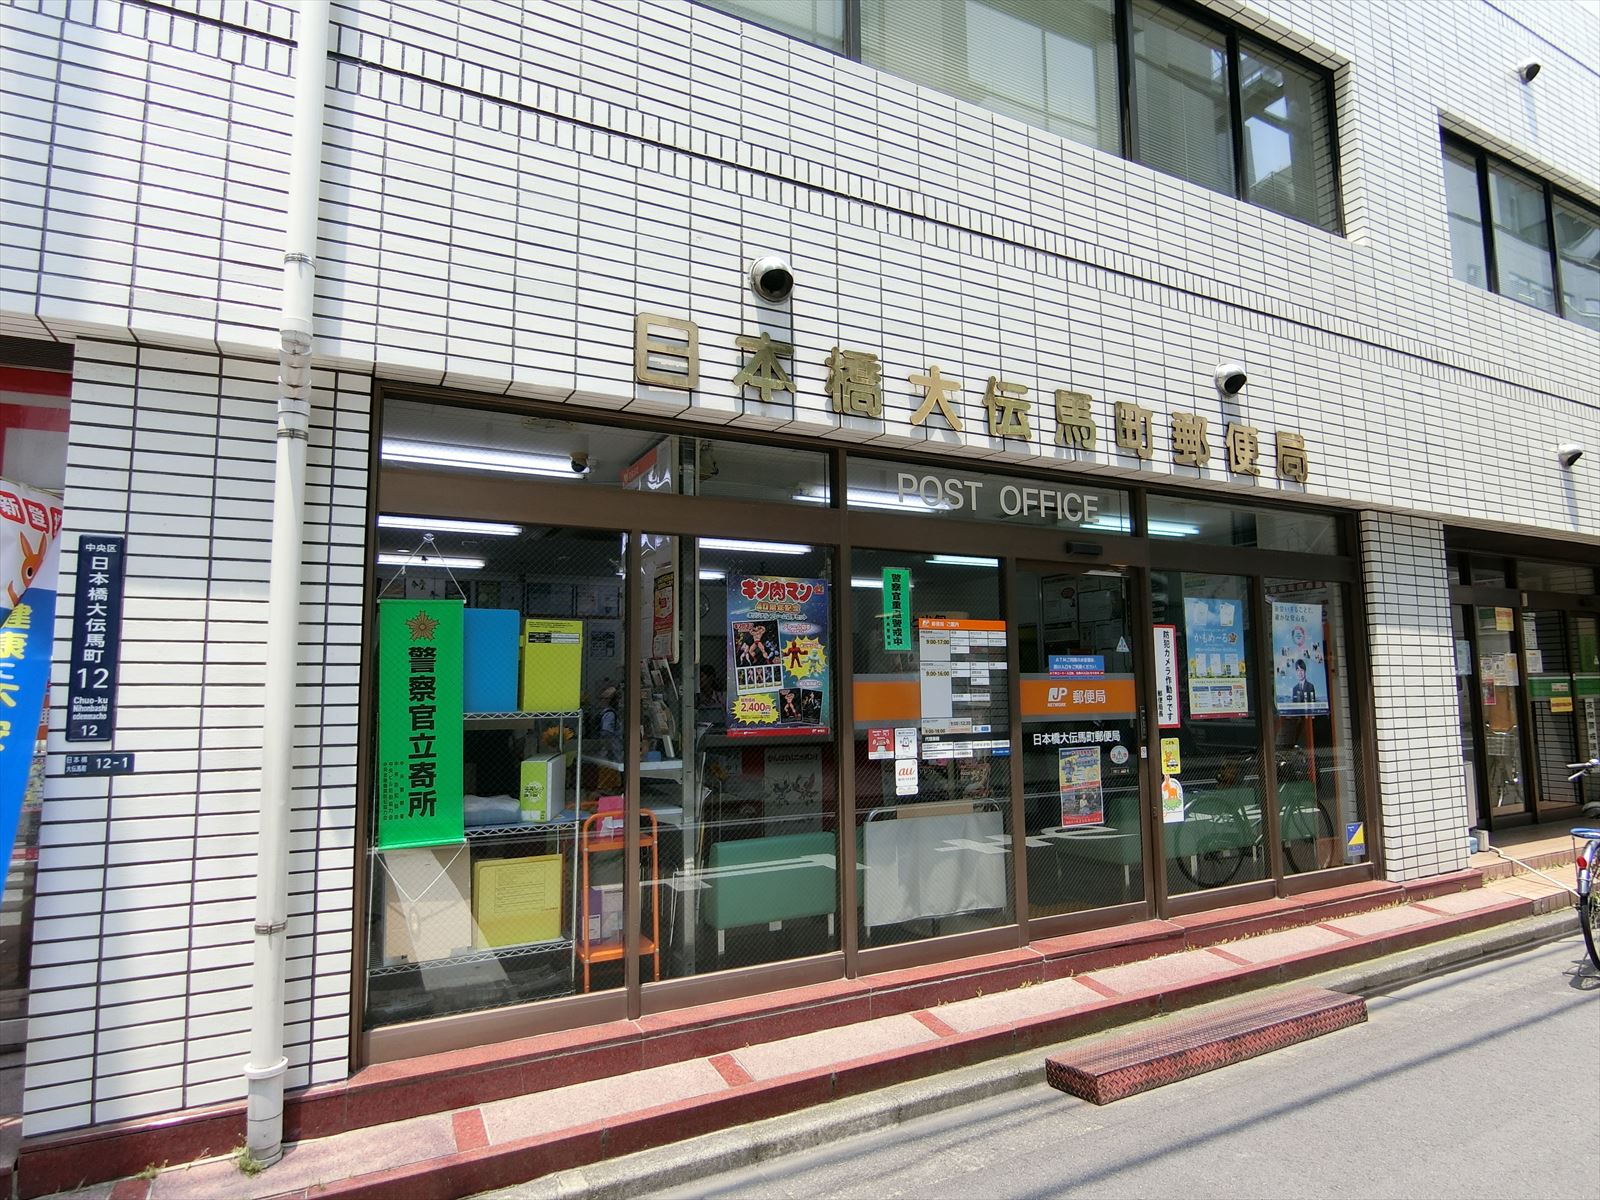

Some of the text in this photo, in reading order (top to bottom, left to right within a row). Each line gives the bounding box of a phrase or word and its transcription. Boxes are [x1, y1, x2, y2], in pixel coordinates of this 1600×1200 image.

[635, 312, 1308, 482] 日本橋大伝馬町郵便局
[897, 473, 1100, 523] POST OFFICE
[85, 543, 117, 553] 中央区
[741, 579, 813, 603] キン肉マン
[83, 556, 109, 663] 日本橋大伝馬町
[77, 668, 109, 689] 12
[1163, 630, 1174, 722] 防犯カメラ作動中です
[73, 696, 108, 704] Chuo-ku
[1072, 690, 1106, 704] 郵便局
[740, 703, 771, 712] 2,400円
[81, 725, 98, 736] 12
[408, 646, 437, 818] 警察官立寄所
[1033, 730, 1120, 745] 日本橋大伝馬町郵便局
[96, 757, 128, 769] 12-1
[898, 768, 914, 777] au
